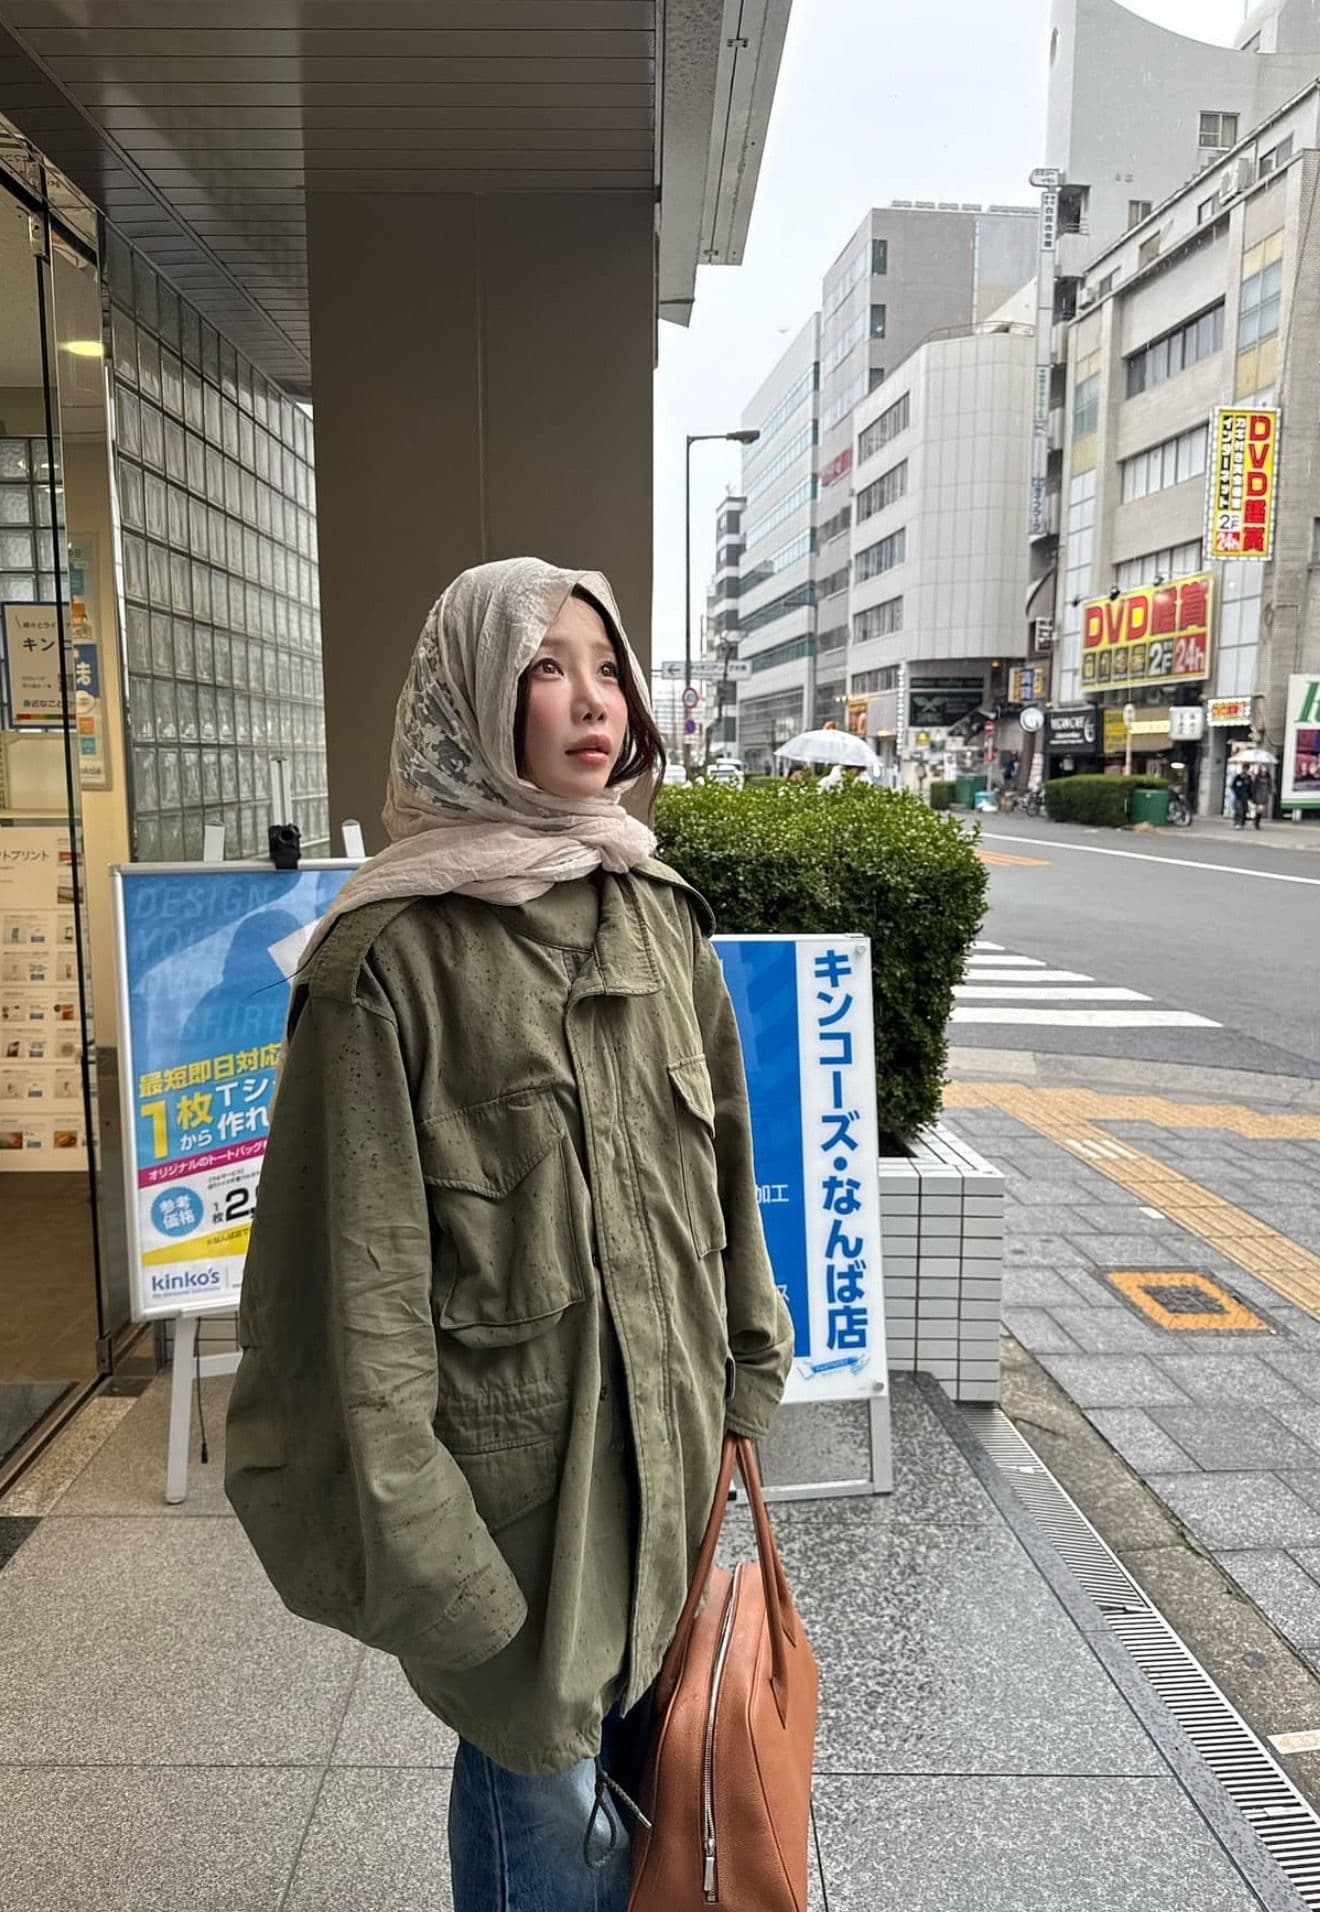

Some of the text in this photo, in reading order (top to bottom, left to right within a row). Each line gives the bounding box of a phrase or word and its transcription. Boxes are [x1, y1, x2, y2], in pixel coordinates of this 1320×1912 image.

[139, 1042, 282, 1098] 最短即日対応
[813, 949, 867, 1350] キンコーズ・なんば店
[152, 1268, 221, 1298] kinko's
